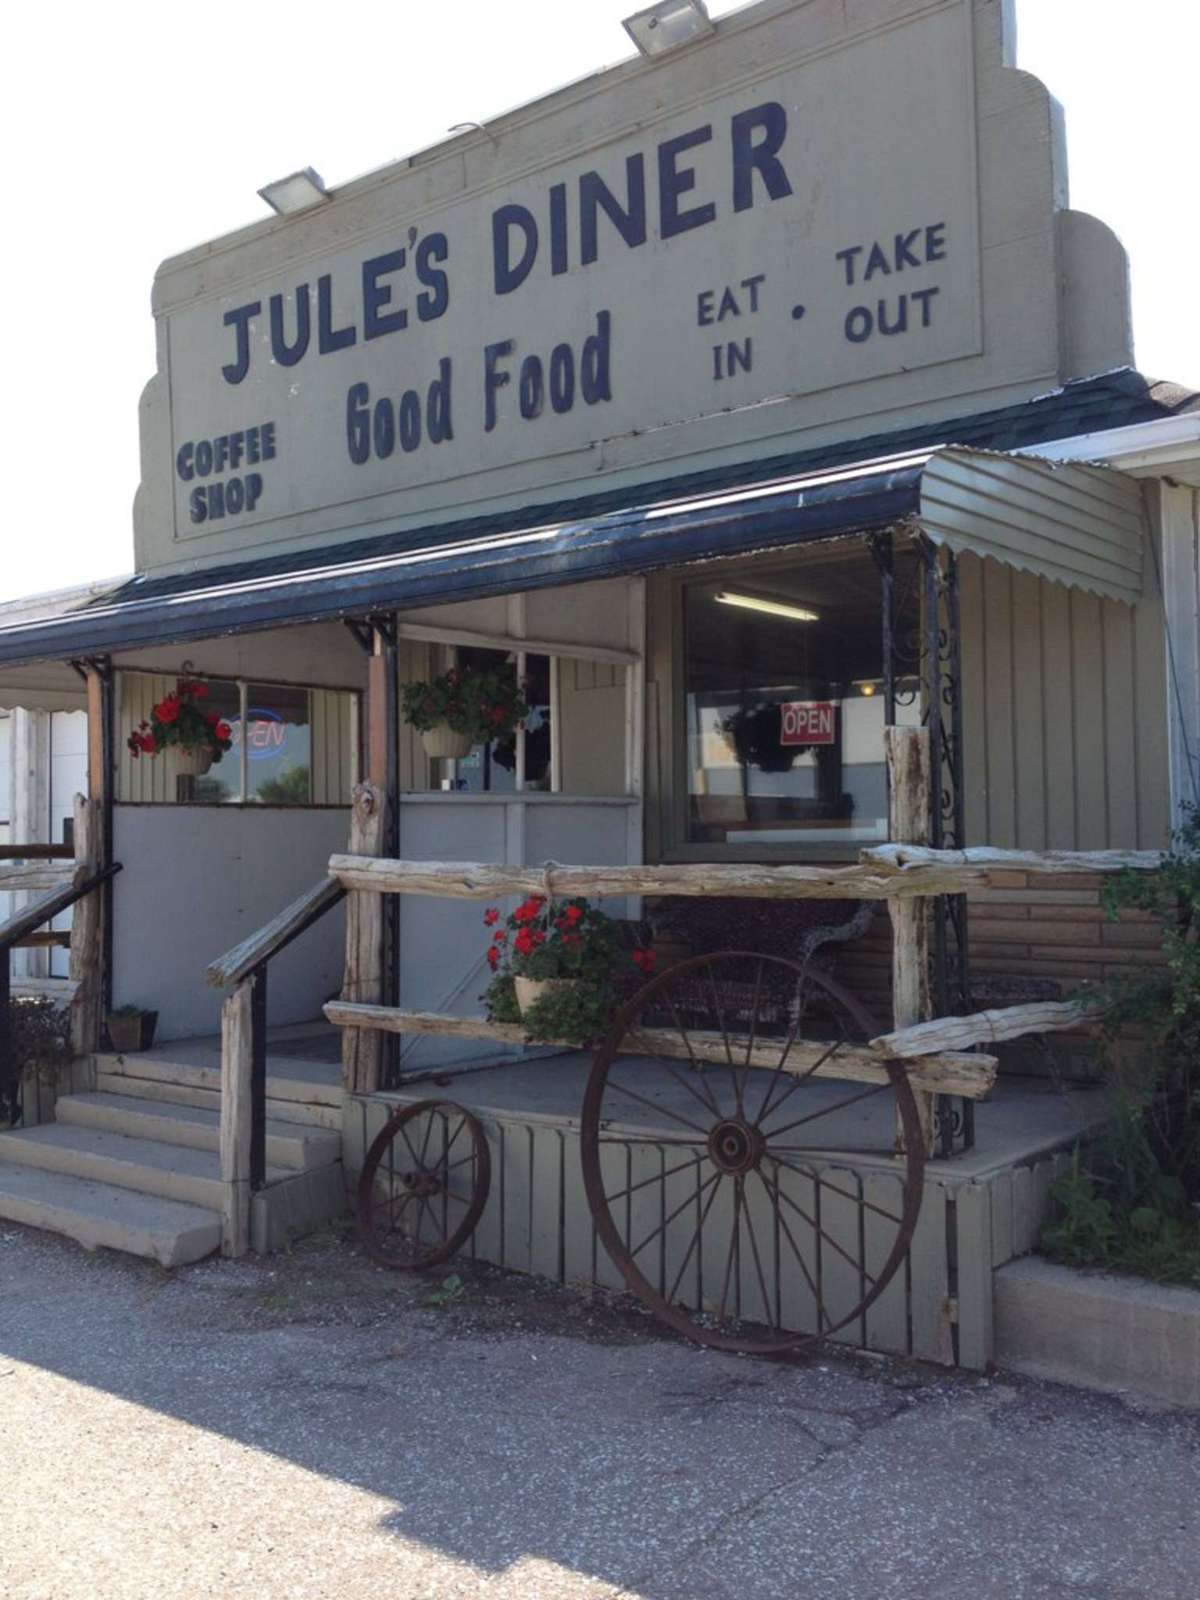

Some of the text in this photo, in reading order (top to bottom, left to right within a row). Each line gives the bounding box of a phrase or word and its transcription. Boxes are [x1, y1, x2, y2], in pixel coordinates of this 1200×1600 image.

[222, 101, 793, 385] JULE'S DINER
[836, 222, 947, 286] TAKE
[697, 274, 766, 327] EAT
[845, 286, 940, 343] OUT
[346, 310, 612, 465] Good Food
[712, 337, 752, 381] IN
[176, 421, 276, 482] COFFEE
[189, 473, 263, 524] SHOP
[783, 709, 832, 736] OPEN
